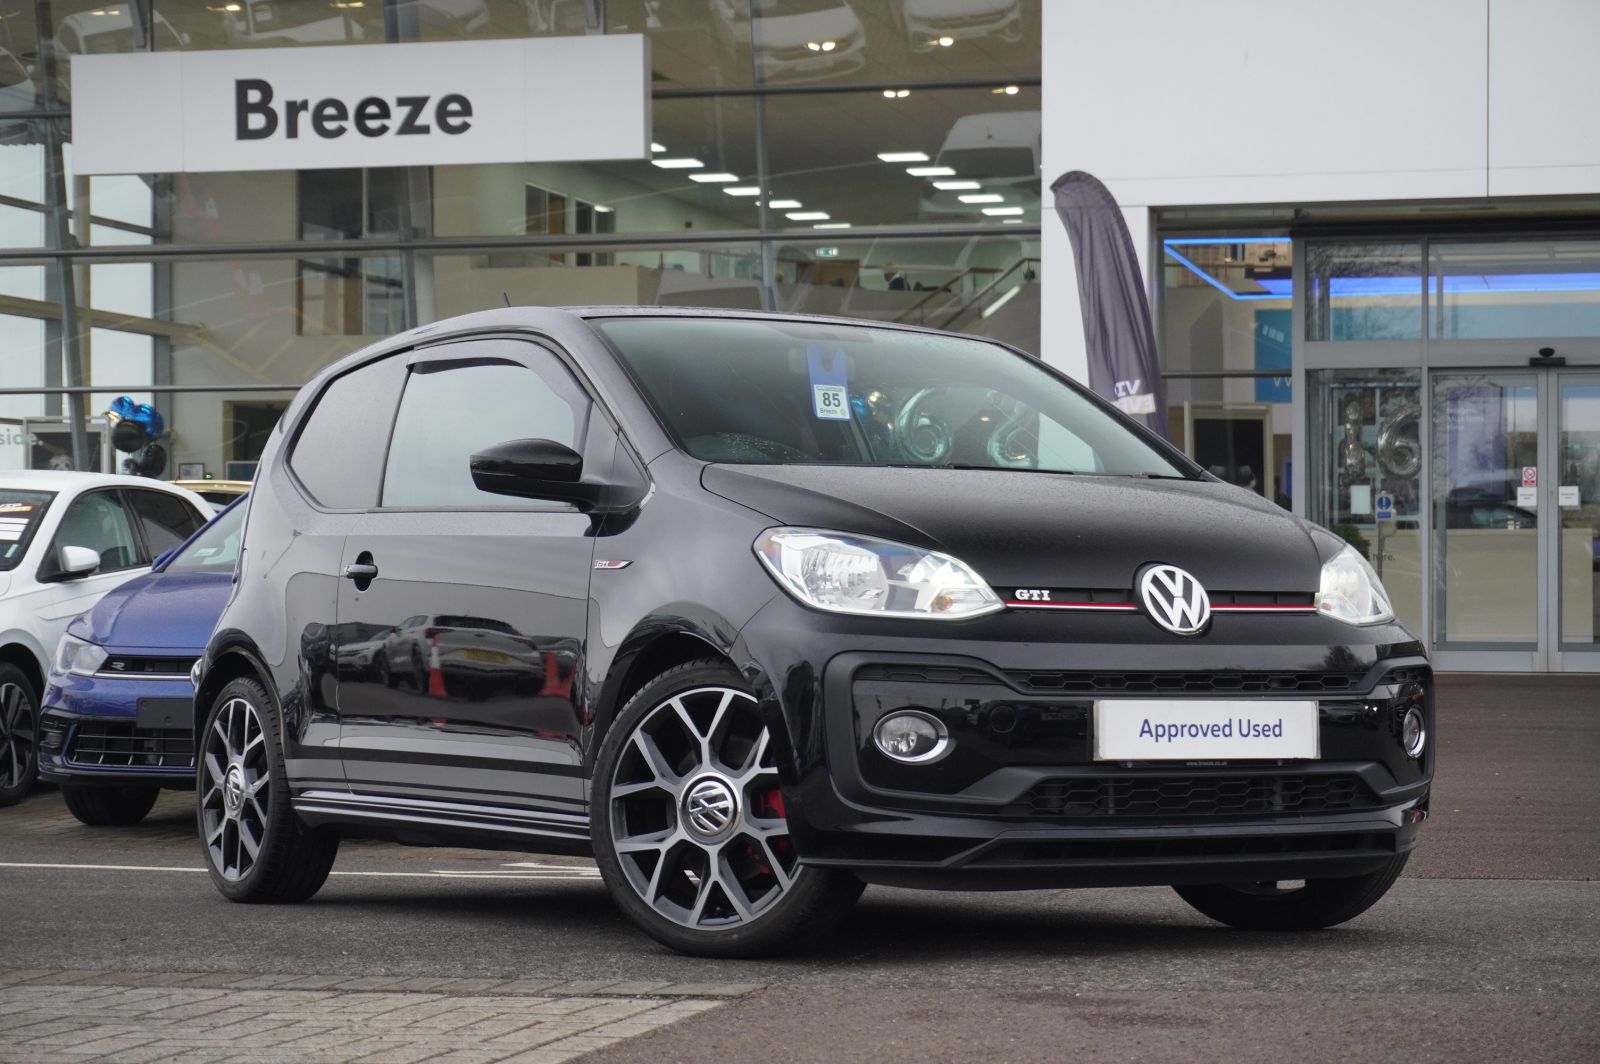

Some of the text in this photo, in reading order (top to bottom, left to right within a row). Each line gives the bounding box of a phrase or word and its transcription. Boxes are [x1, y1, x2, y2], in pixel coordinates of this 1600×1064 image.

[234, 78, 473, 141] Breeze
[822, 392, 841, 407] 85
[1015, 589, 1051, 601] GTI
[1139, 718, 1283, 743] Approved Used
